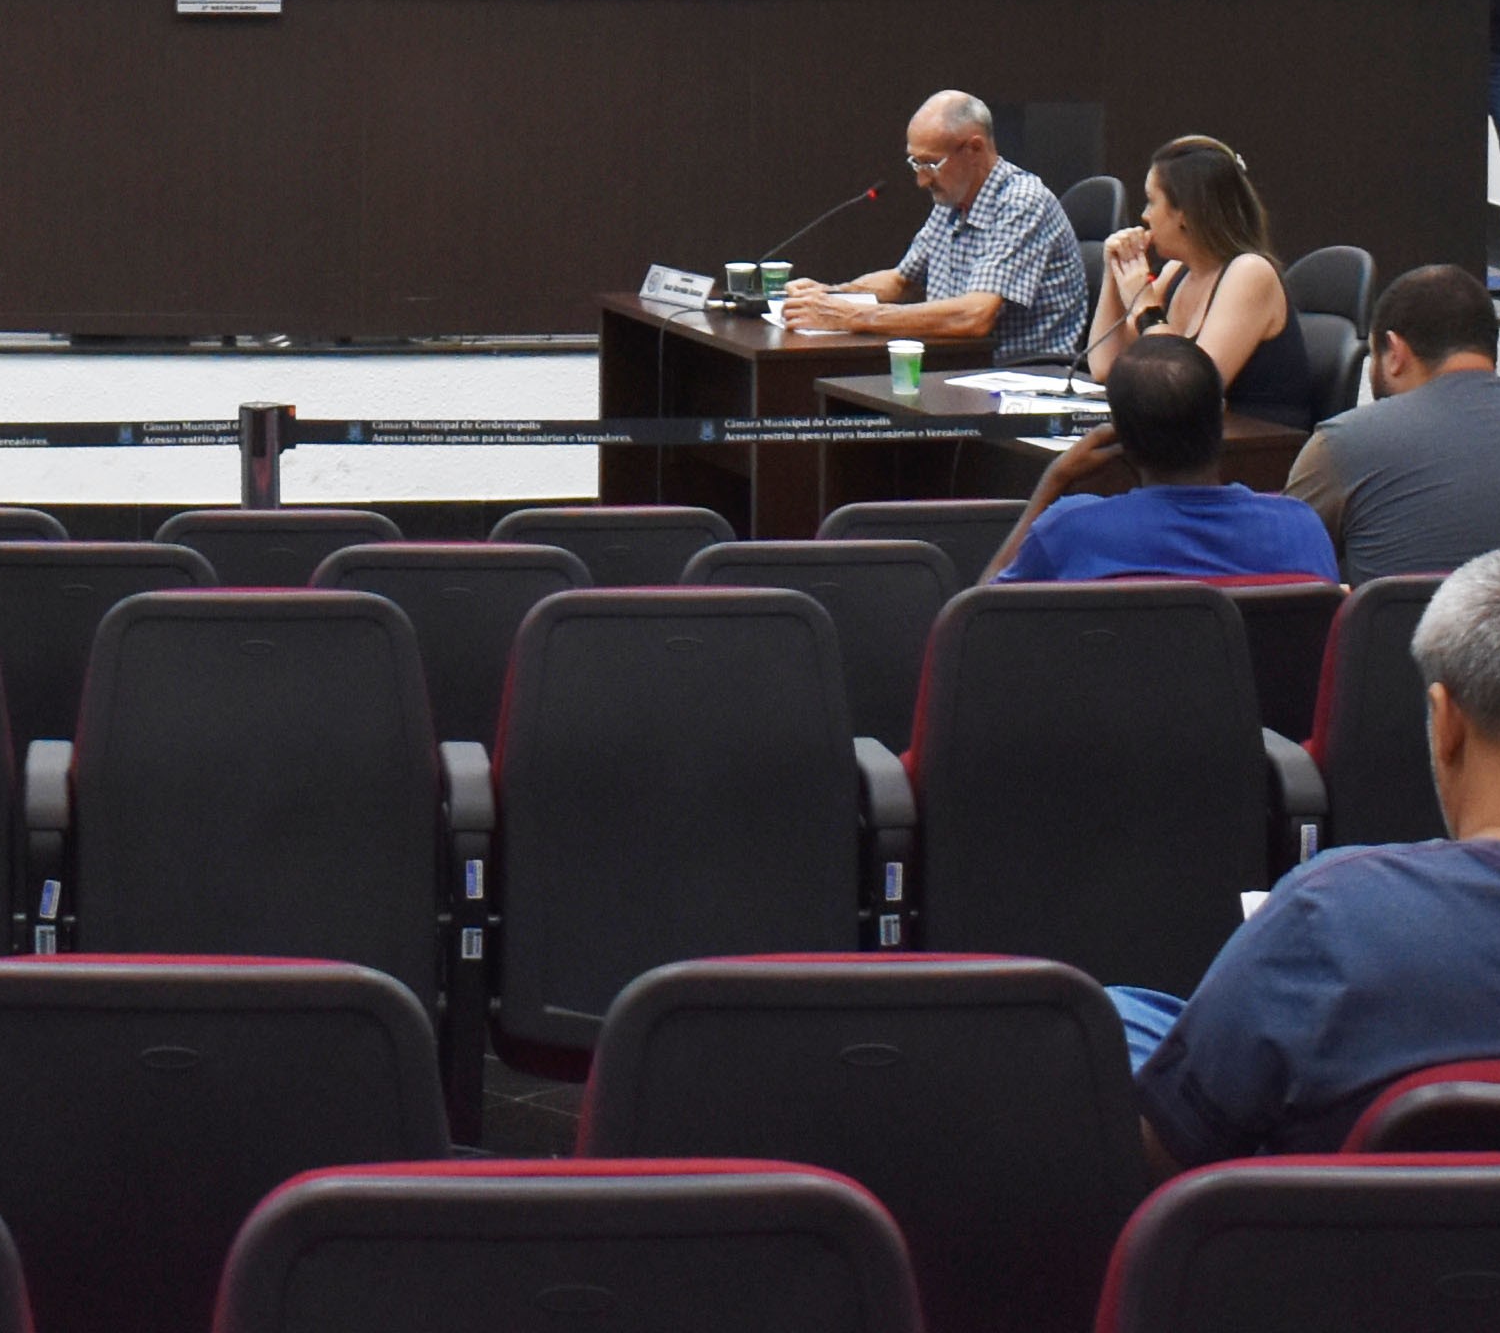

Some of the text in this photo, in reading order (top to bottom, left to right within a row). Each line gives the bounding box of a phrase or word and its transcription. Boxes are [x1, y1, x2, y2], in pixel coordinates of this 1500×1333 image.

[143, 422, 180, 431] Câmara
[181, 421, 231, 432] Municipal
[372, 420, 541, 432] Câmara Municipal de Cordeirópolis
[142, 436, 176, 444] Acesso
[178, 435, 216, 444] restrito
[371, 433, 406, 442] Acesso
[407, 433, 444, 442] restrito
[446, 434, 481, 444] apenas
[482, 434, 505, 445] para
[506, 432, 567, 443] funcionários
